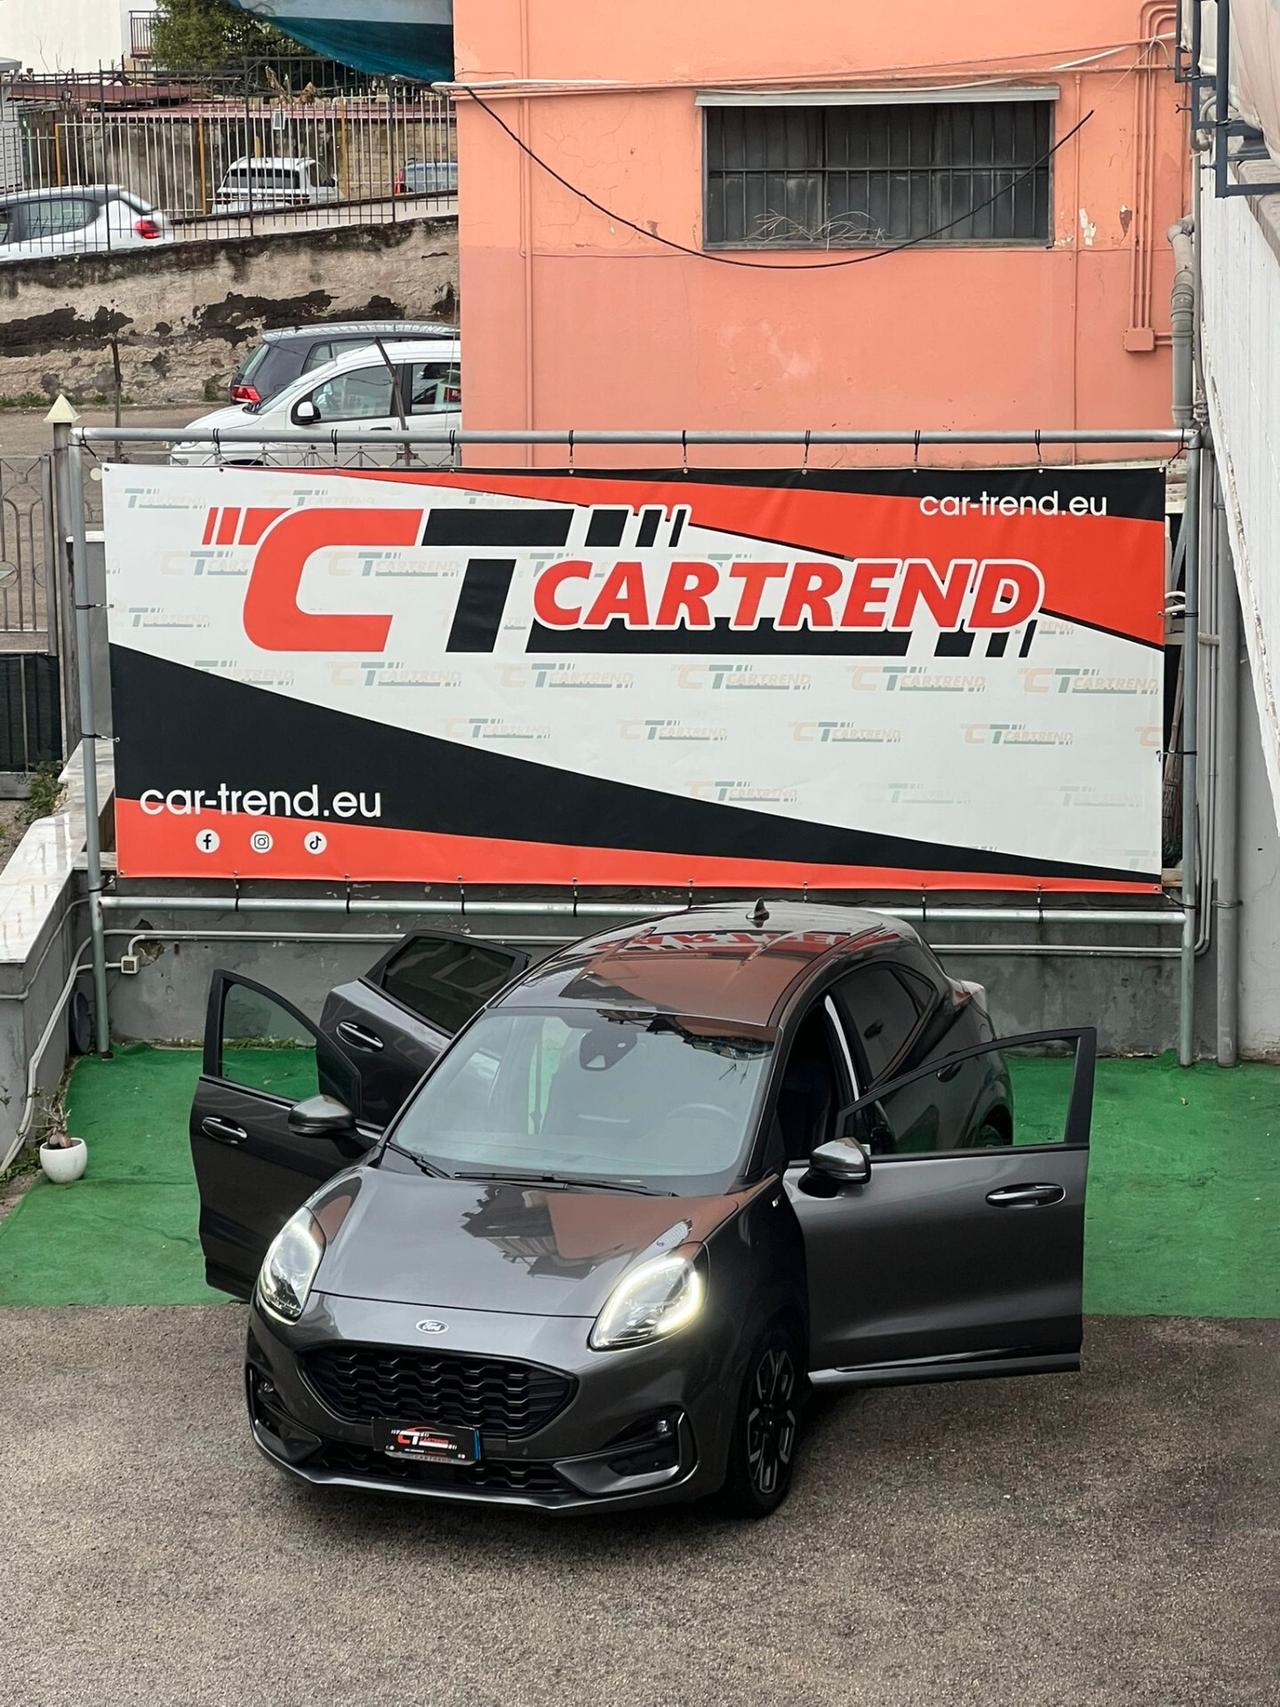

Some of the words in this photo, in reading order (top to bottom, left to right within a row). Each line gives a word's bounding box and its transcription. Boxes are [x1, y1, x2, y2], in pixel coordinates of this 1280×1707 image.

[919, 491, 1107, 518] car-trend.eu
[243, 507, 576, 654] CT
[533, 559, 1043, 631] CARTREND
[1073, 677, 1160, 690] CARTREND
[139, 783, 382, 818] car-trend.eu
